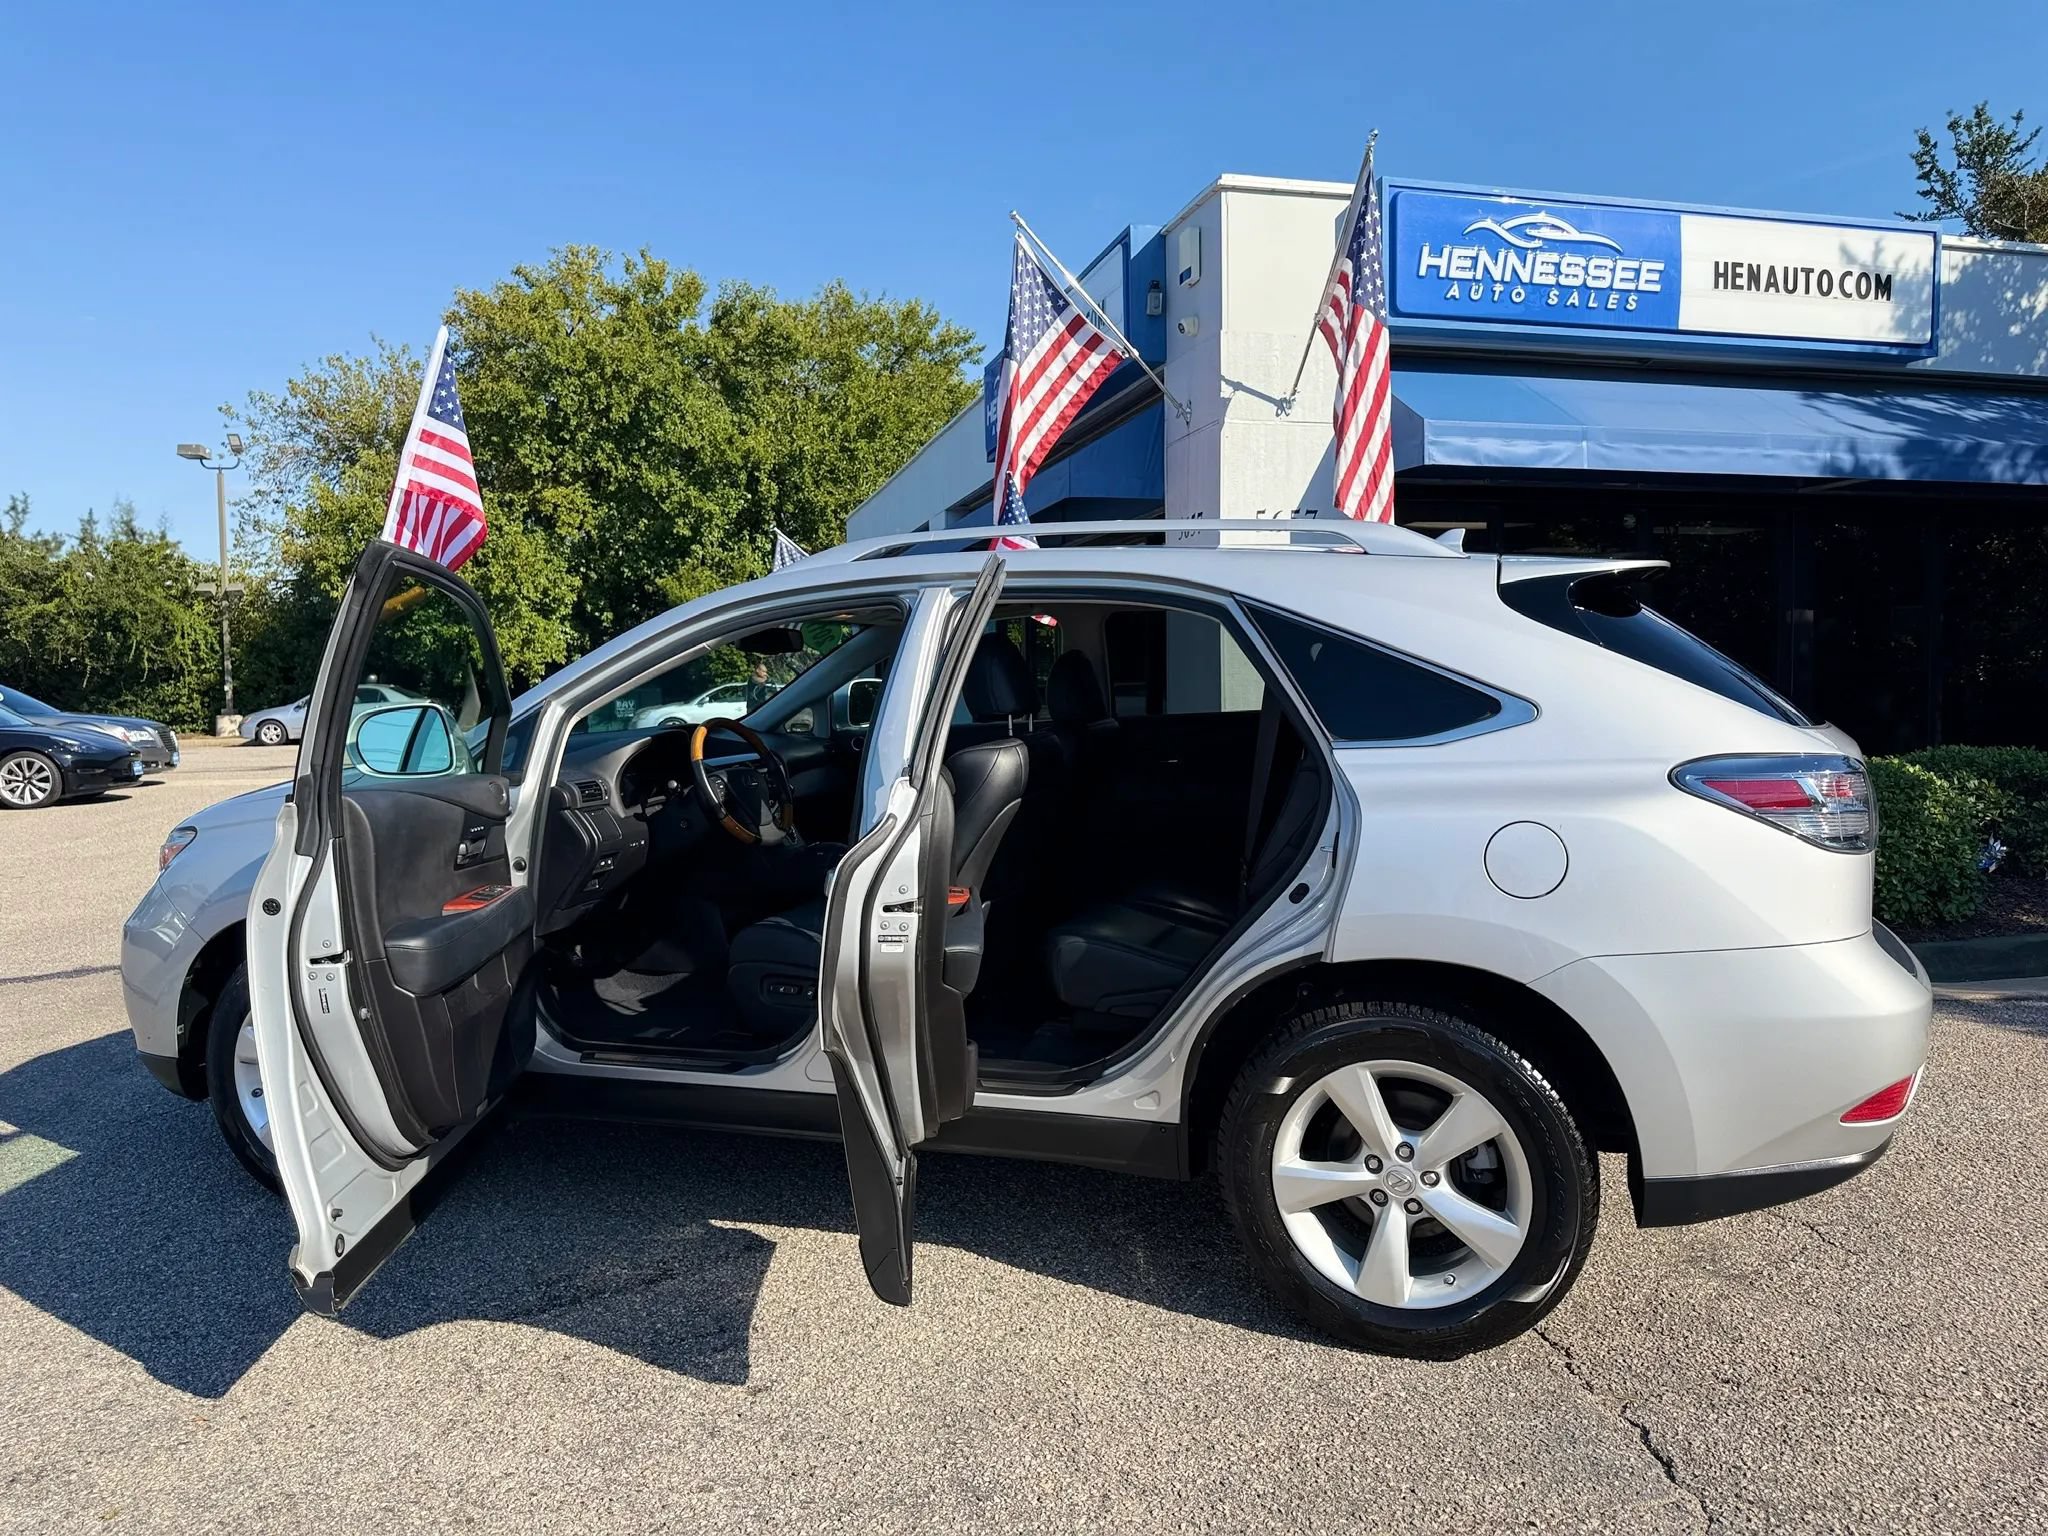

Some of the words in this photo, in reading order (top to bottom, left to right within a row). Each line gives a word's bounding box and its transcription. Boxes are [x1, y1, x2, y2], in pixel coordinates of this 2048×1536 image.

[1417, 243, 1665, 293] HENNESSEE
[1713, 260, 1893, 302] HENAUTO.COM
[1446, 281, 1527, 303] AUTO
[1546, 289, 1639, 311] SALES
